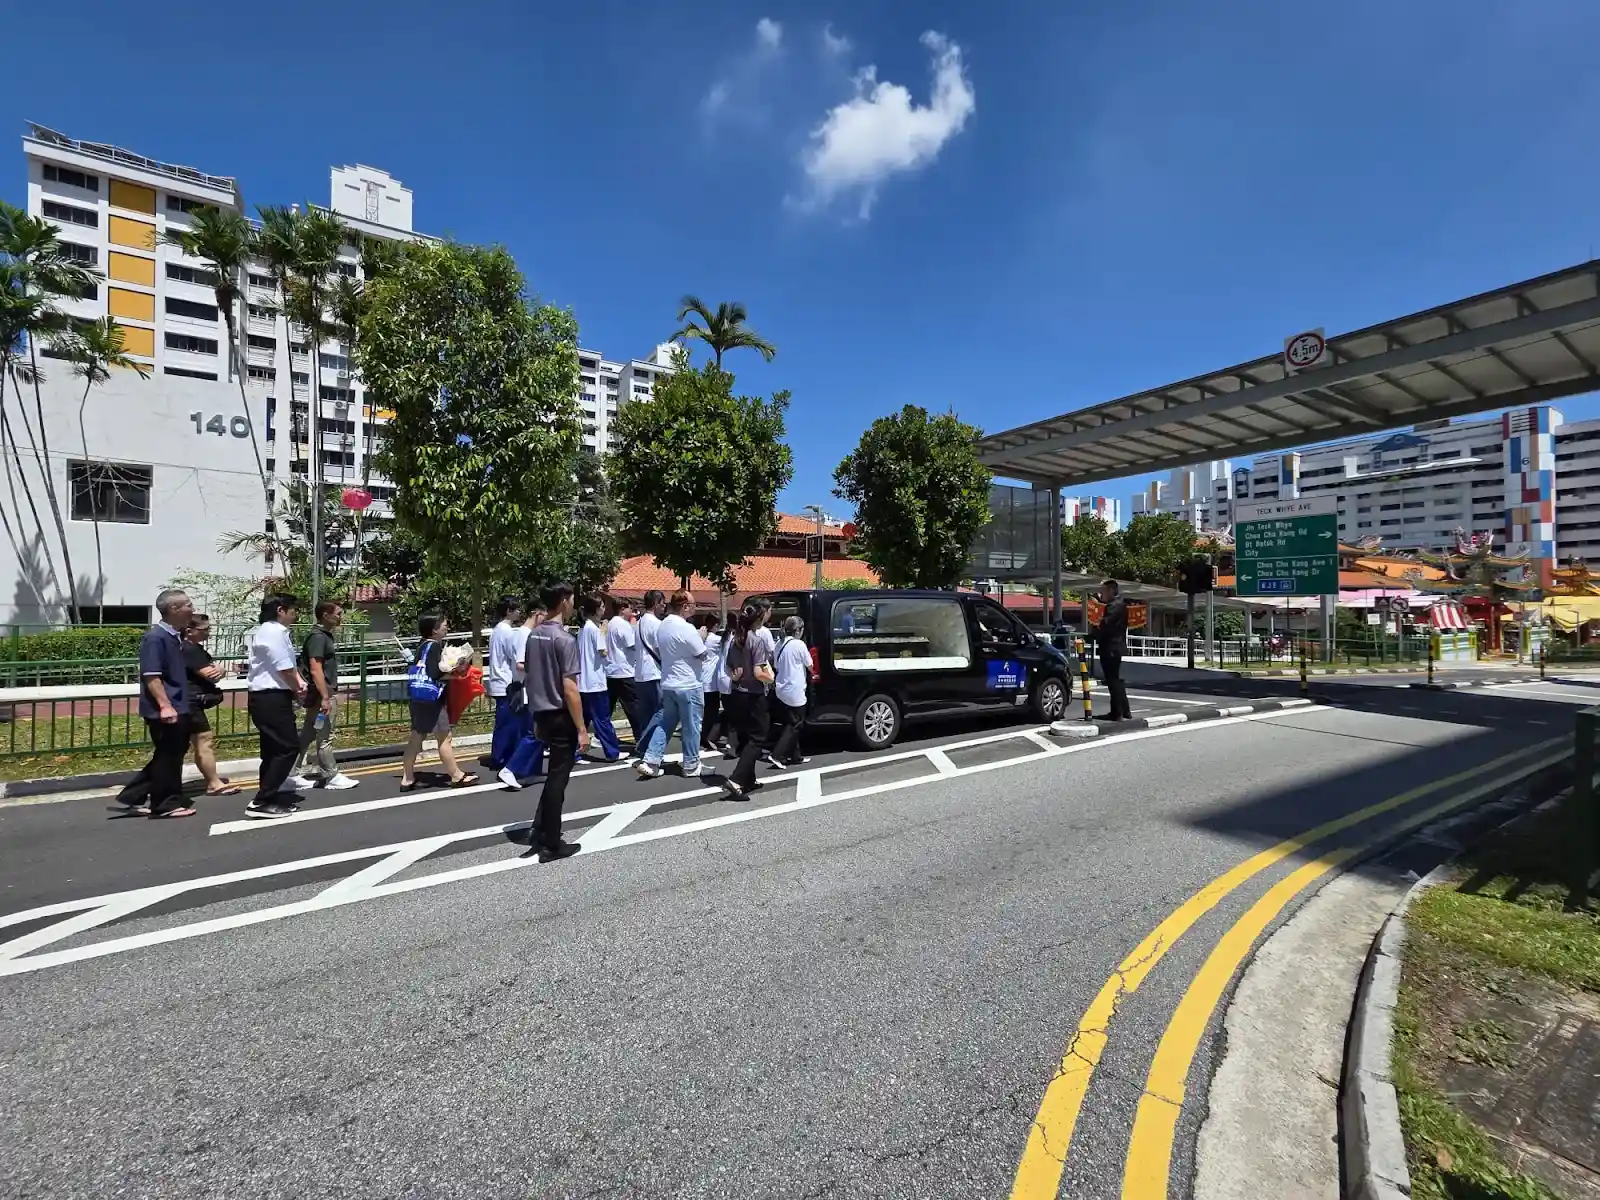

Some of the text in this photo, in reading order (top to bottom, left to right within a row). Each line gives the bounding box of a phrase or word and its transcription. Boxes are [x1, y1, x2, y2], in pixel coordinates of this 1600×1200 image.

[1292, 344, 1318, 357] 4.5m
[190, 411, 249, 438] 140
[1276, 505, 1294, 513] WHYE
[1298, 503, 1312, 511] AVE
